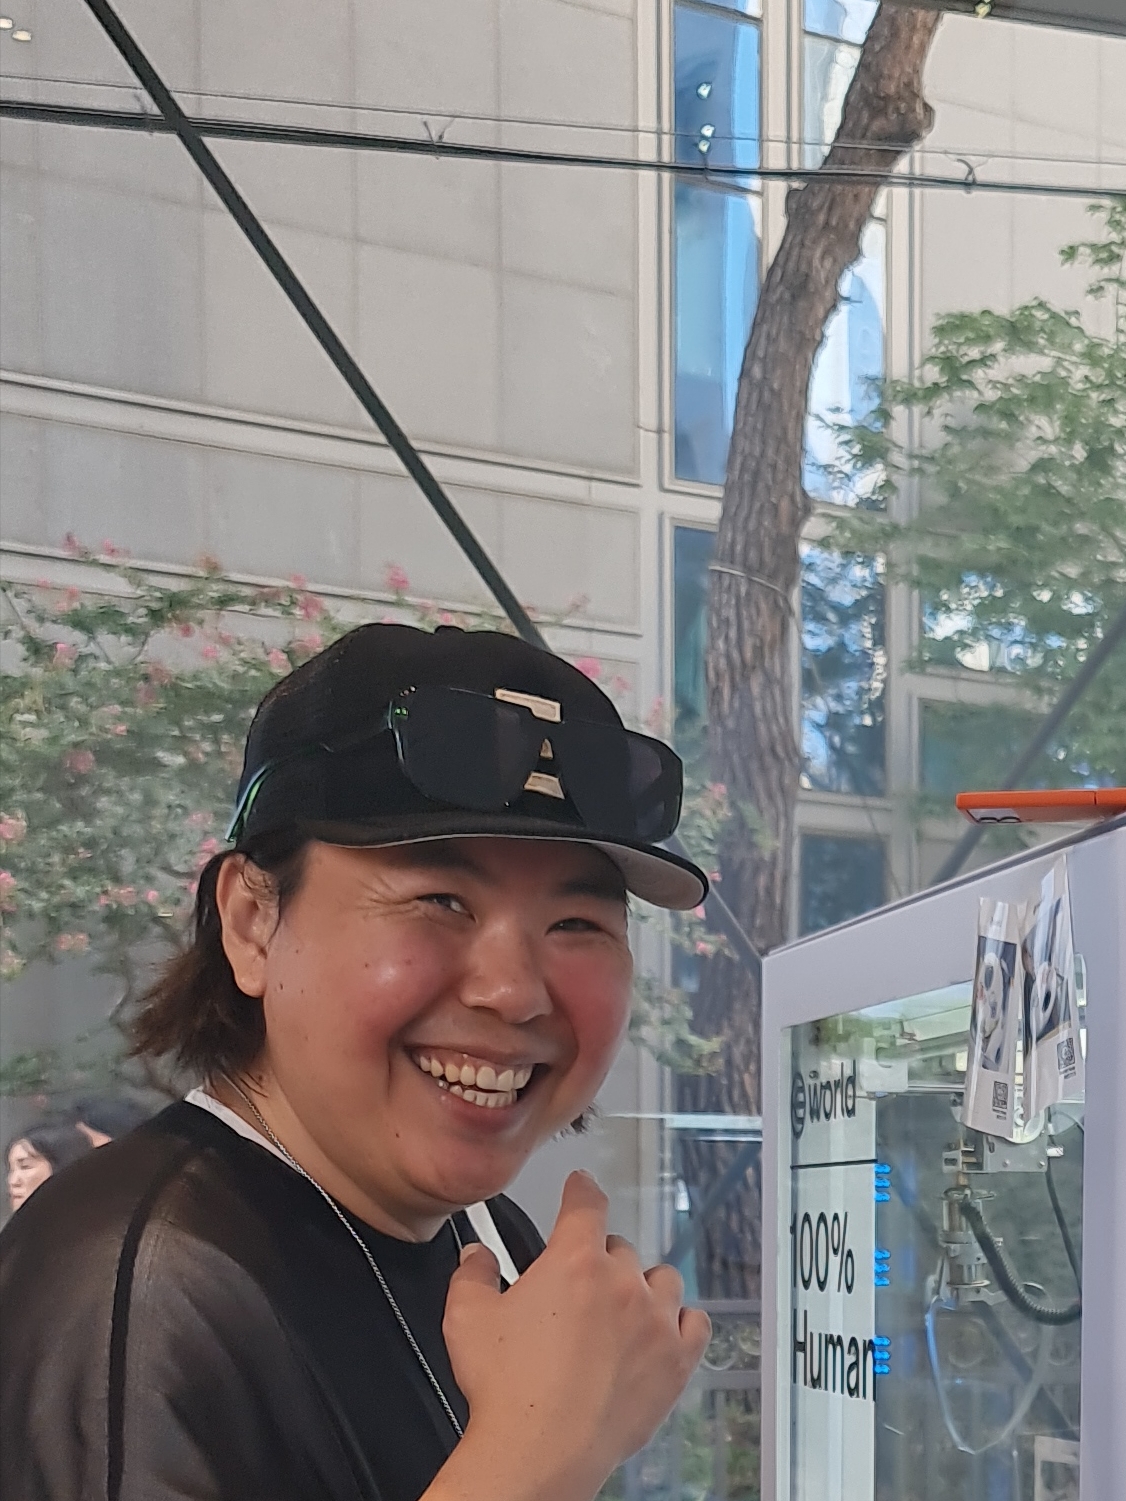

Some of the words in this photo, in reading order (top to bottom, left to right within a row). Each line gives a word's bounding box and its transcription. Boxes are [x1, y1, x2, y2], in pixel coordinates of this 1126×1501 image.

[808, 1059, 856, 1123] world
[793, 1211, 855, 1294] 100%
[793, 1308, 876, 1402] Human
